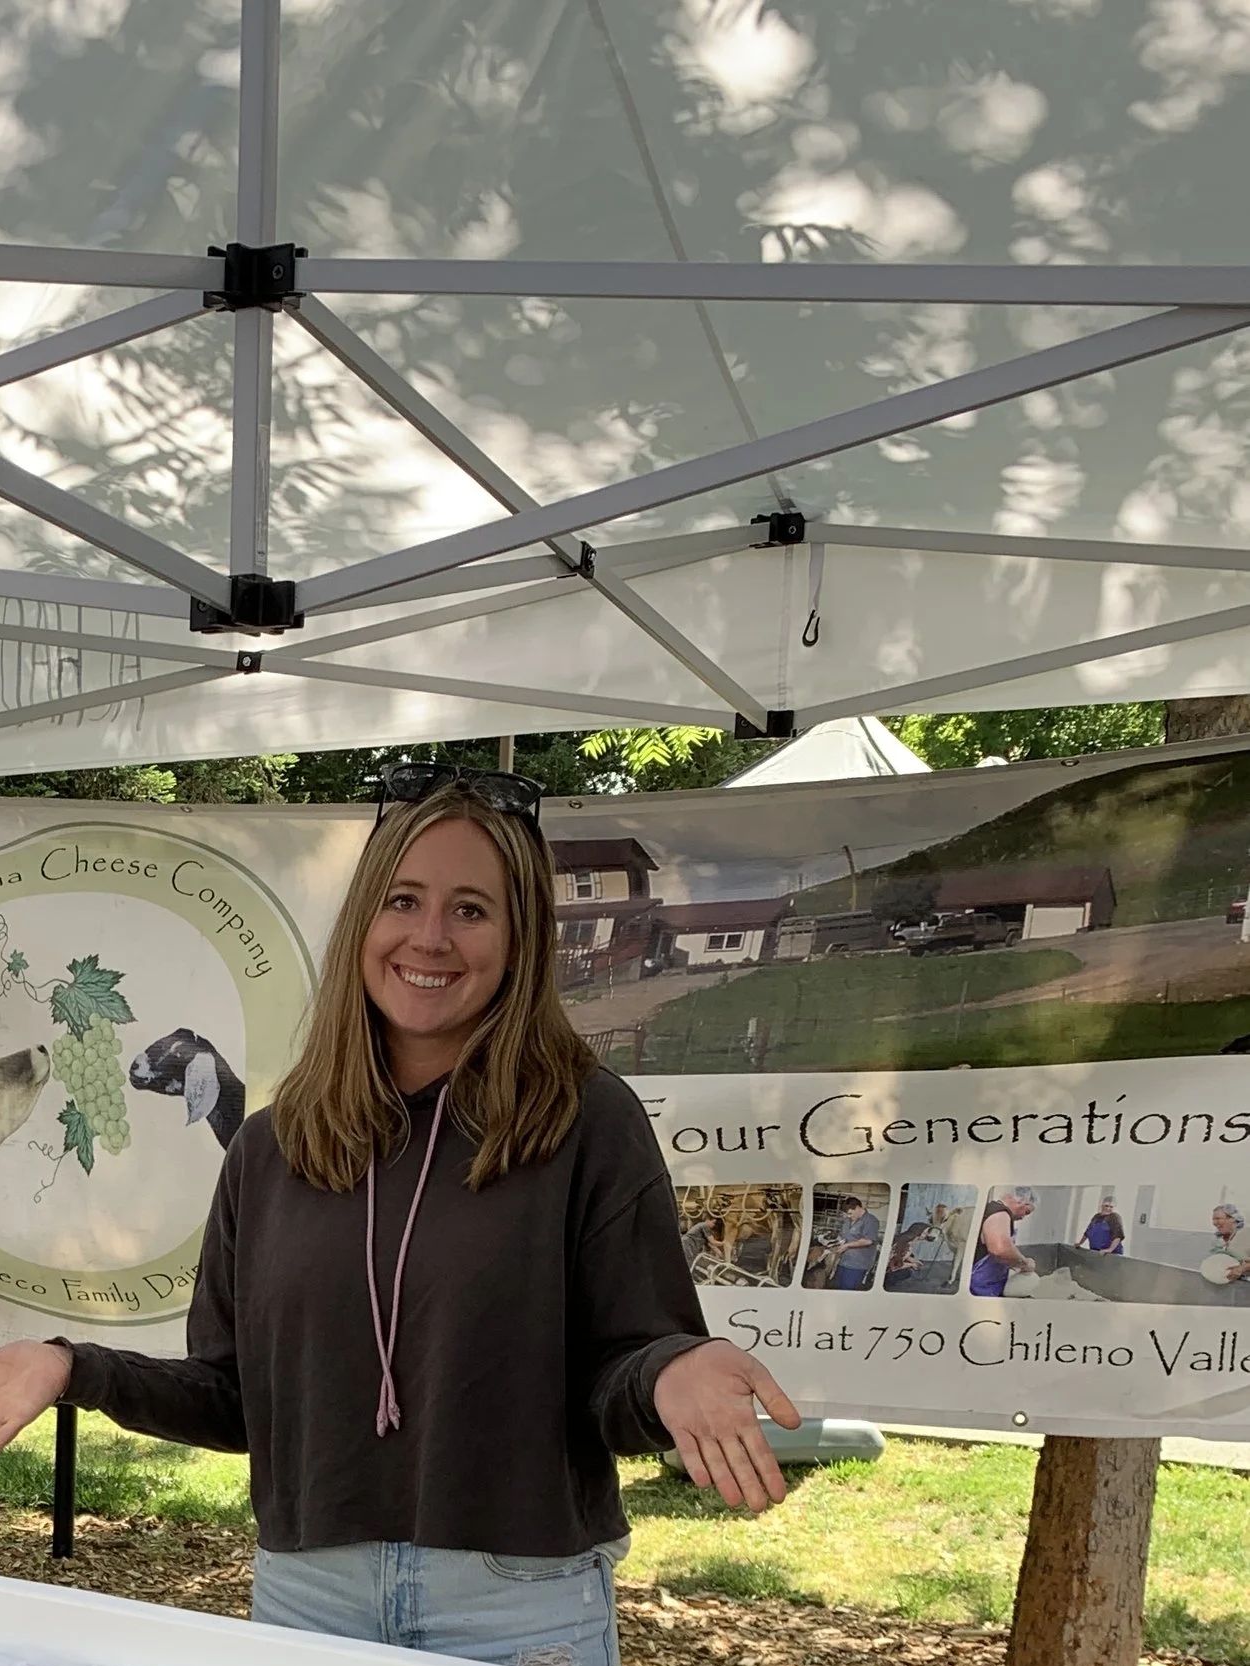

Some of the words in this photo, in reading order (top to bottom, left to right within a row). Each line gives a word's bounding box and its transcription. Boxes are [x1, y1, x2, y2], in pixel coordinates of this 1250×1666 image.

[40, 846, 159, 882] Cheese
[170, 859, 273, 979] Company
[799, 1094, 1250, 1158] Generations
[61, 1278, 141, 1312] Family
[727, 1309, 803, 1353] Sell
[814, 1325, 853, 1352] at
[863, 1326, 946, 1361] 750
[959, 1320, 1133, 1367] Chileno
